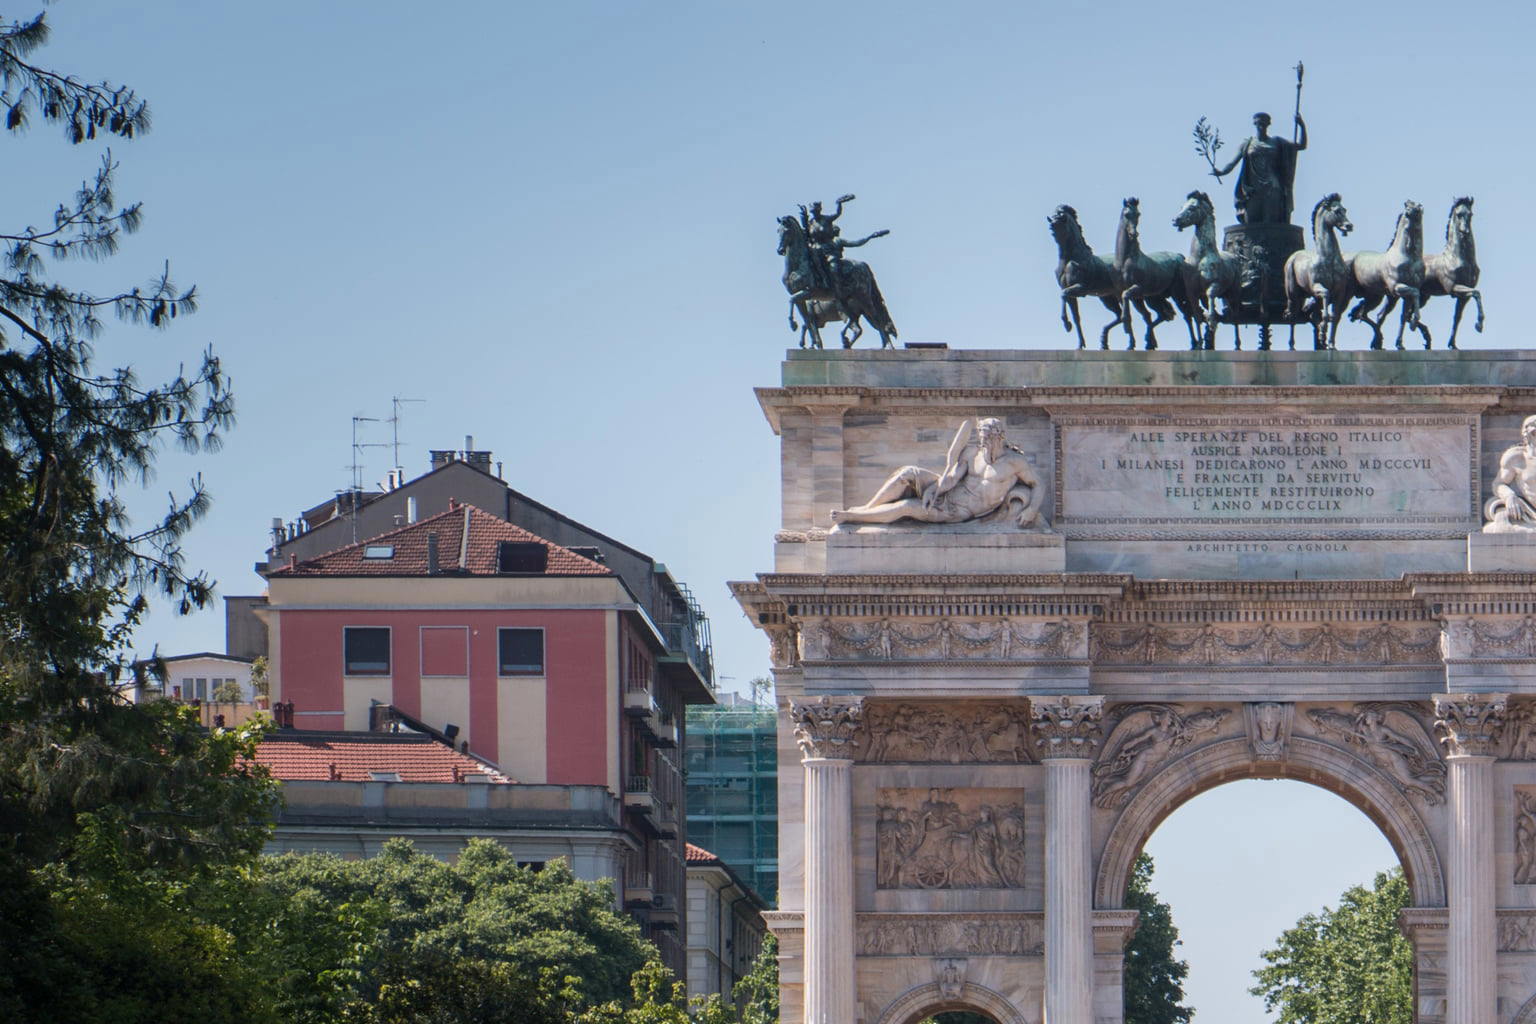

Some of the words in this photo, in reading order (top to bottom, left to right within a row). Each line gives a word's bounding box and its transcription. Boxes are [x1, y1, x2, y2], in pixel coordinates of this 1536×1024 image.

[1130, 432, 1165, 442] ALLE
[1174, 432, 1249, 443] SPERANZE
[1258, 432, 1283, 443] DEL
[1294, 432, 1339, 443] REGNO
[1349, 432, 1402, 442] ITALICO
[1191, 446, 1242, 457] AUSPICE
[1251, 446, 1327, 457] NAPOLEONE
[1116, 460, 1184, 470] MILANESI
[1195, 460, 1286, 470] DEDICARONO
[1311, 460, 1348, 470] ANNO
[1359, 459, 1431, 470] MDCCCVII
[1194, 474, 1264, 484] FRANCATI
[1165, 487, 1260, 498] FELICEMENTE
[1270, 487, 1375, 498] RESTITUIRONO
[1211, 500, 1252, 511] ANNO
[1261, 500, 1342, 511] MDCCCLIX
[1187, 543, 1269, 553] ARCHITETTO
[1286, 543, 1348, 553] CAGNOLA
